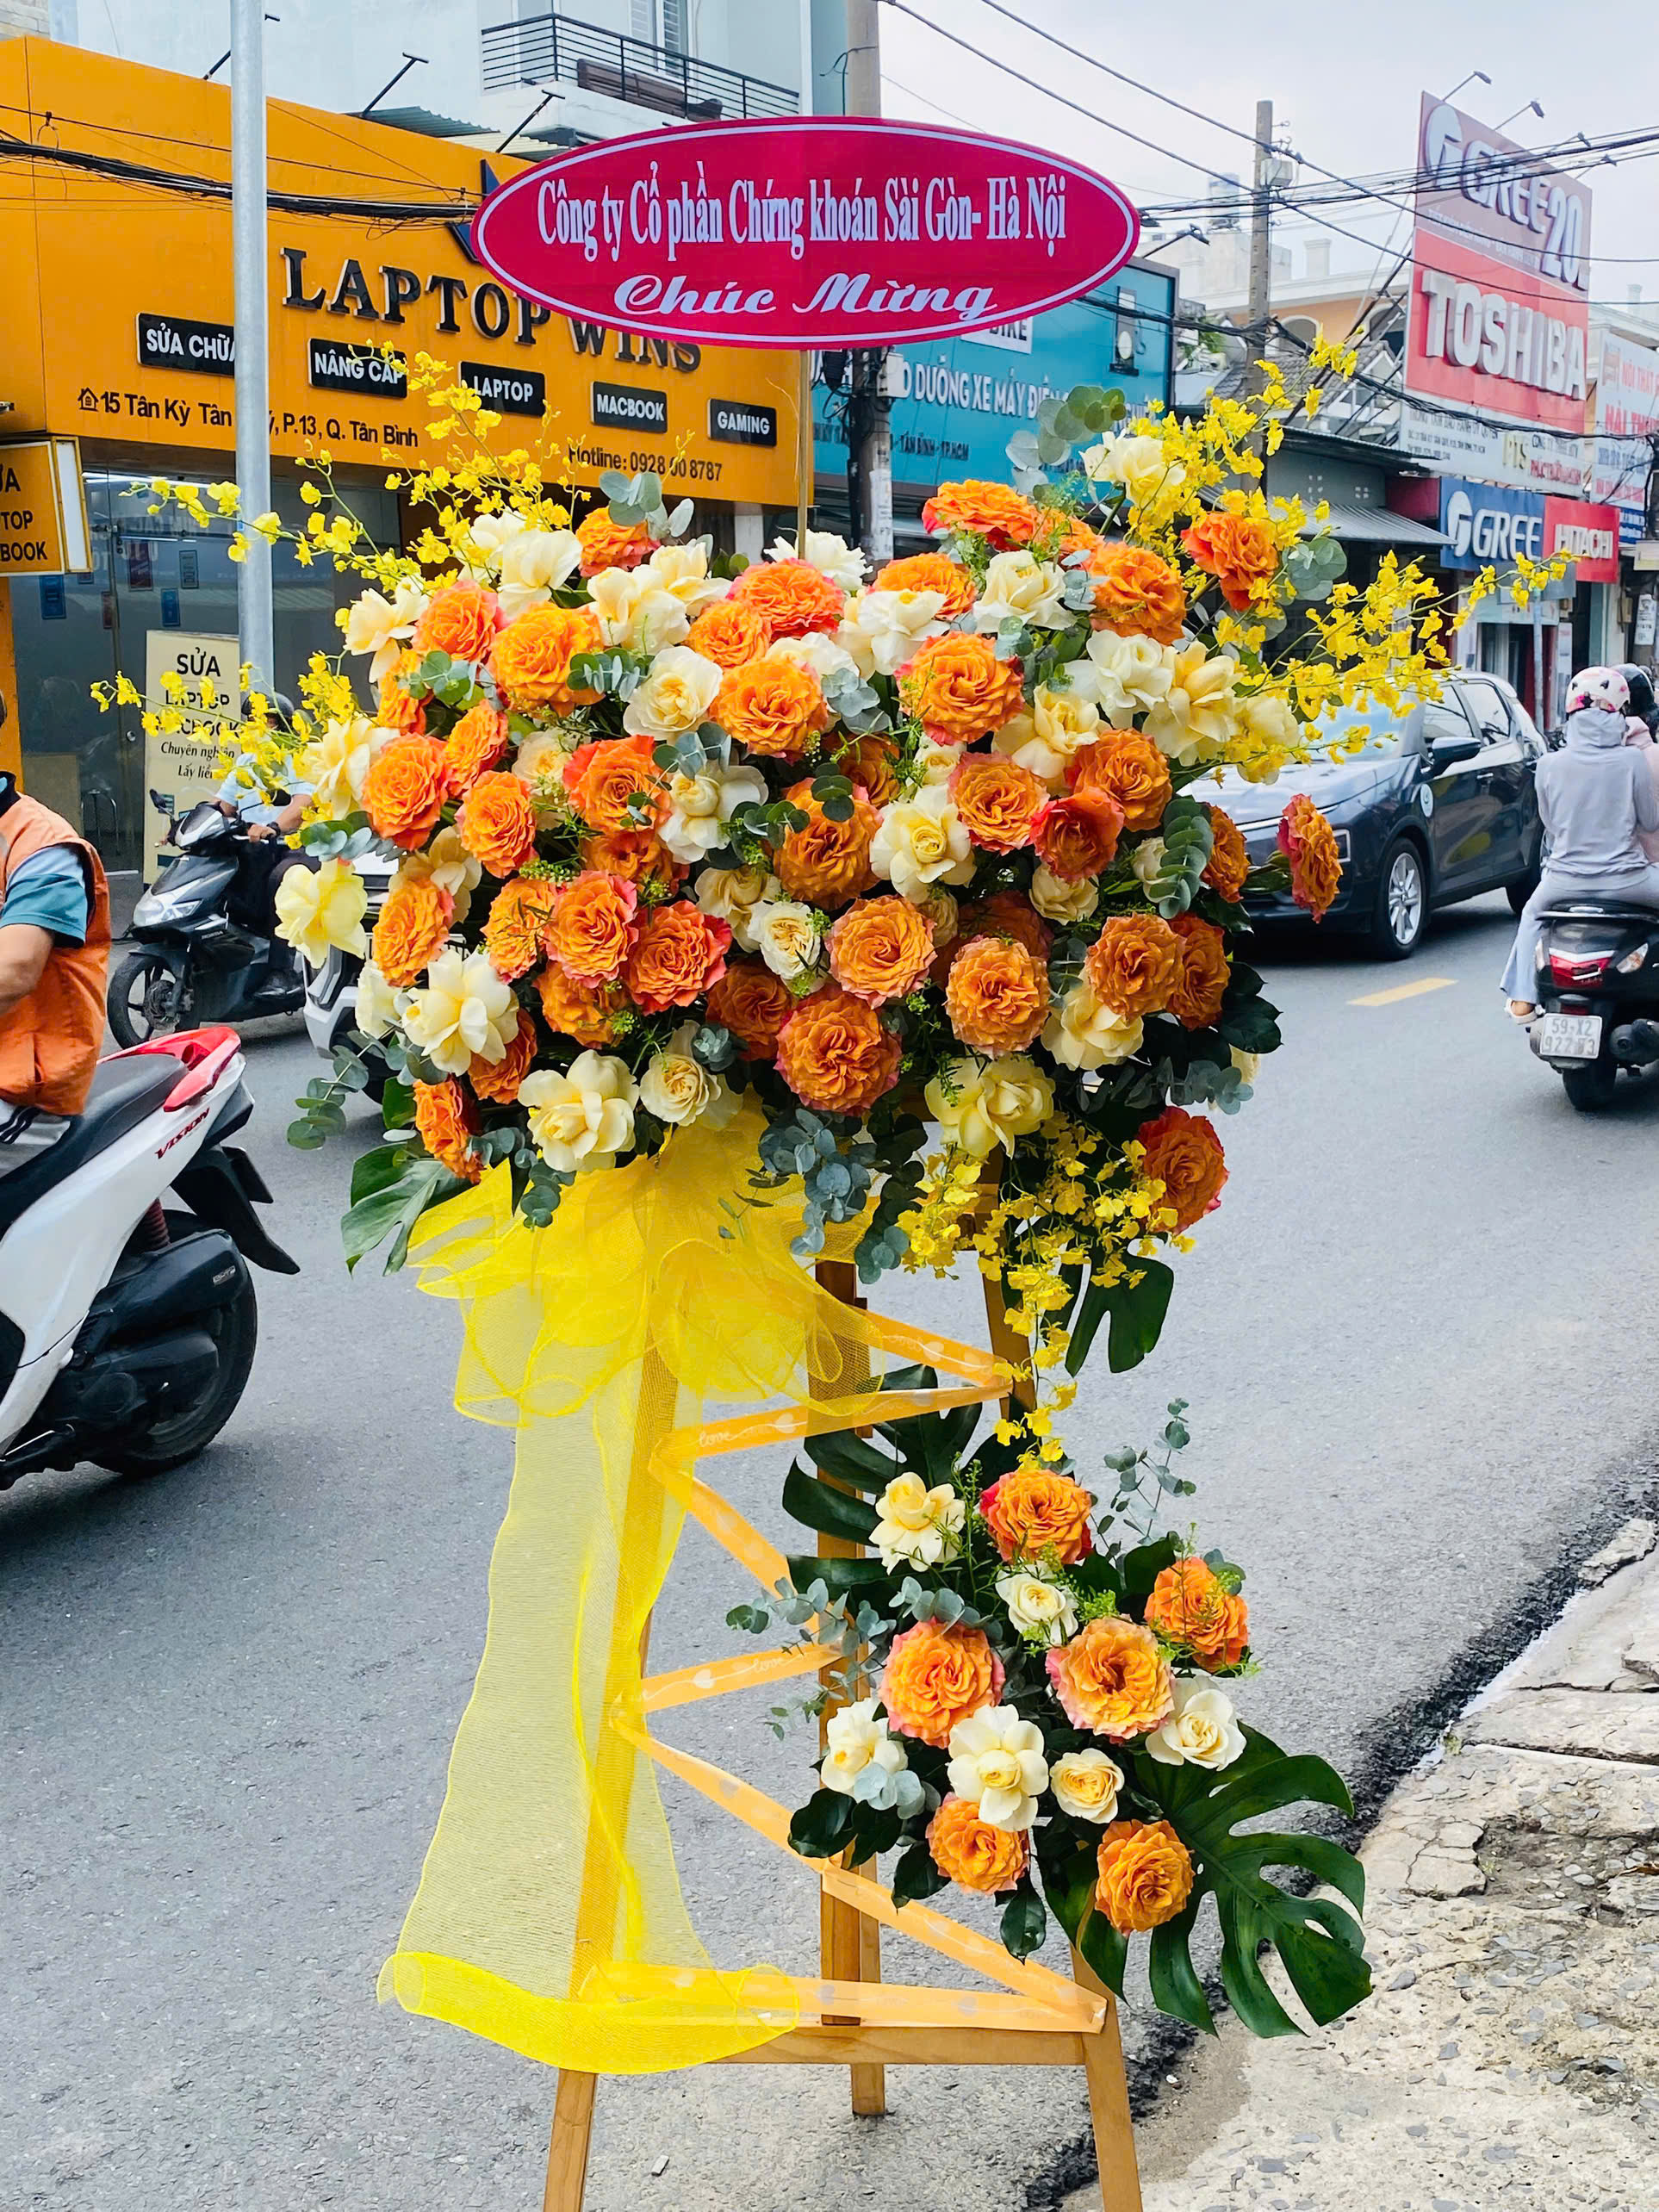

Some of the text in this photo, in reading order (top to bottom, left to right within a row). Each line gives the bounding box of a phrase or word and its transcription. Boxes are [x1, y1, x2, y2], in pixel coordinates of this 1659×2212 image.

[538, 178, 598, 262] Công
[602, 185, 624, 261] ty
[630, 161, 662, 244] Cổ
[667, 161, 724, 261] phần
[729, 178, 805, 260] Chứng
[810, 177, 879, 241] khoán
[884, 177, 919, 242] Sài
[986, 177, 1020, 239] Hà
[1025, 174, 1066, 257] Nội
[280, 247, 701, 372] LAPTOP WINS
[614, 273, 997, 320] Chúc Mừng
[146, 322, 184, 355] SỬA
[1421, 270, 1586, 400] TOSHIBA
[314, 349, 364, 379] NÂNG
[473, 376, 533, 402] LAPTOP
[972, 374, 991, 413] XE
[994, 367, 1026, 417] MÁY
[101, 391, 121, 413] 15
[124, 393, 160, 419] Tân
[165, 399, 190, 427] Kỳ
[198, 403, 232, 427] Tân
[326, 419, 345, 440] Q.
[349, 420, 378, 444] Tân
[383, 425, 418, 447] Bình
[597, 394, 665, 421] MACBOOK
[717, 411, 770, 435] GAMING
[569, 444, 627, 470] Hotline:
[631, 451, 666, 475] 0928
[690, 459, 723, 482] 8787
[1472, 508, 1543, 561] GREE
[1555, 524, 1613, 559] HITACHI
[177, 647, 221, 677] SỬA
[161, 742, 197, 759] Chuyên
[178, 763, 195, 780] Lấy
